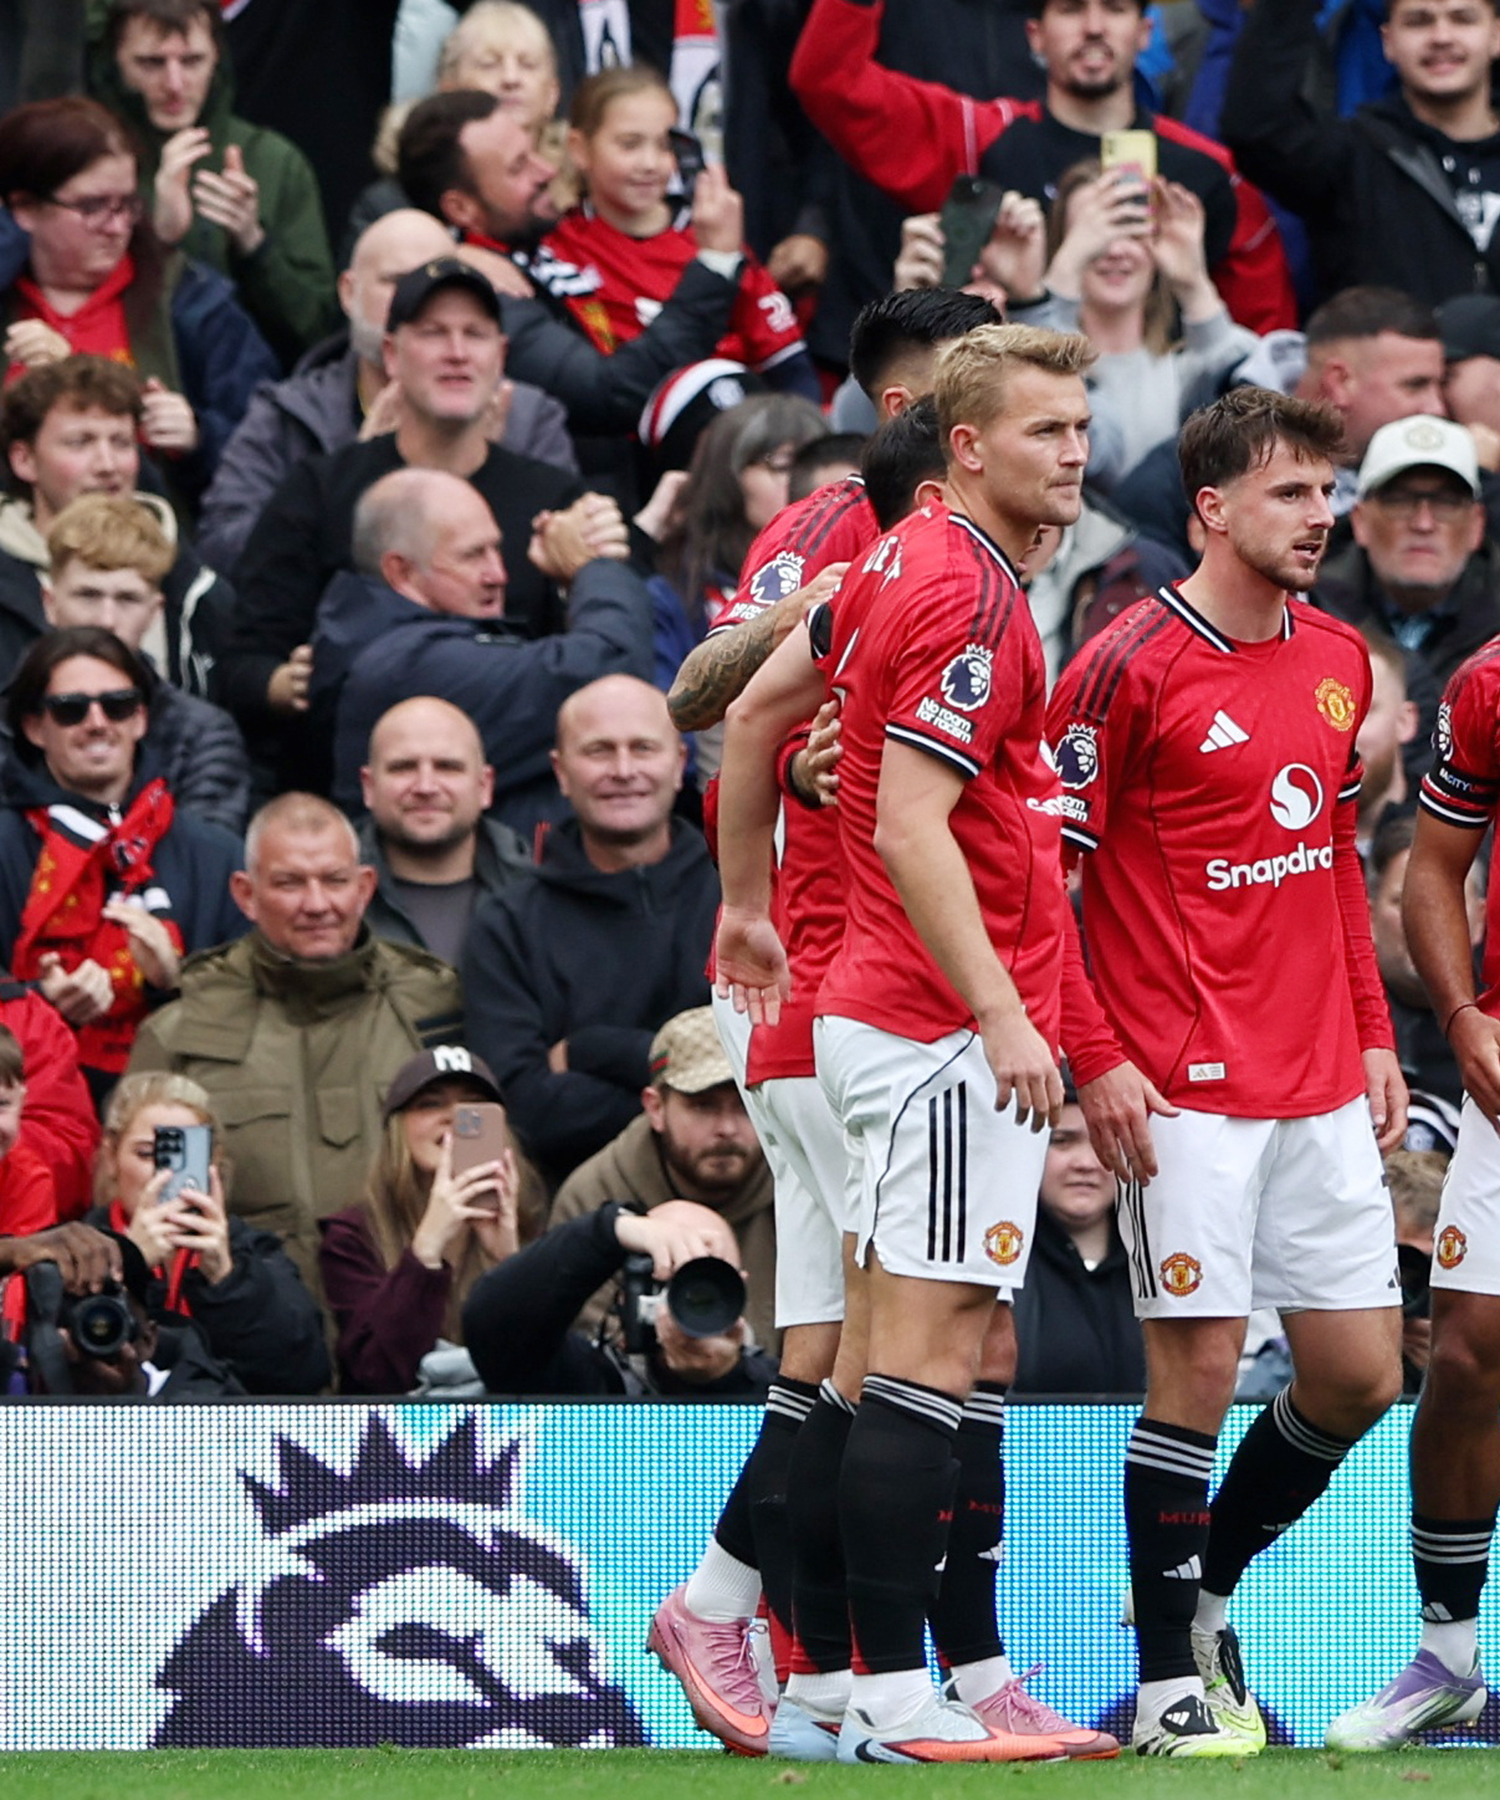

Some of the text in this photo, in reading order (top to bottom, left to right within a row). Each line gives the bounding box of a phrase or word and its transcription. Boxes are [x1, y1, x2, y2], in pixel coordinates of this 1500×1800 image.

[915, 709, 972, 745] for racism
[918, 696, 972, 732] No room
[1206, 841, 1333, 891] Snapdra
